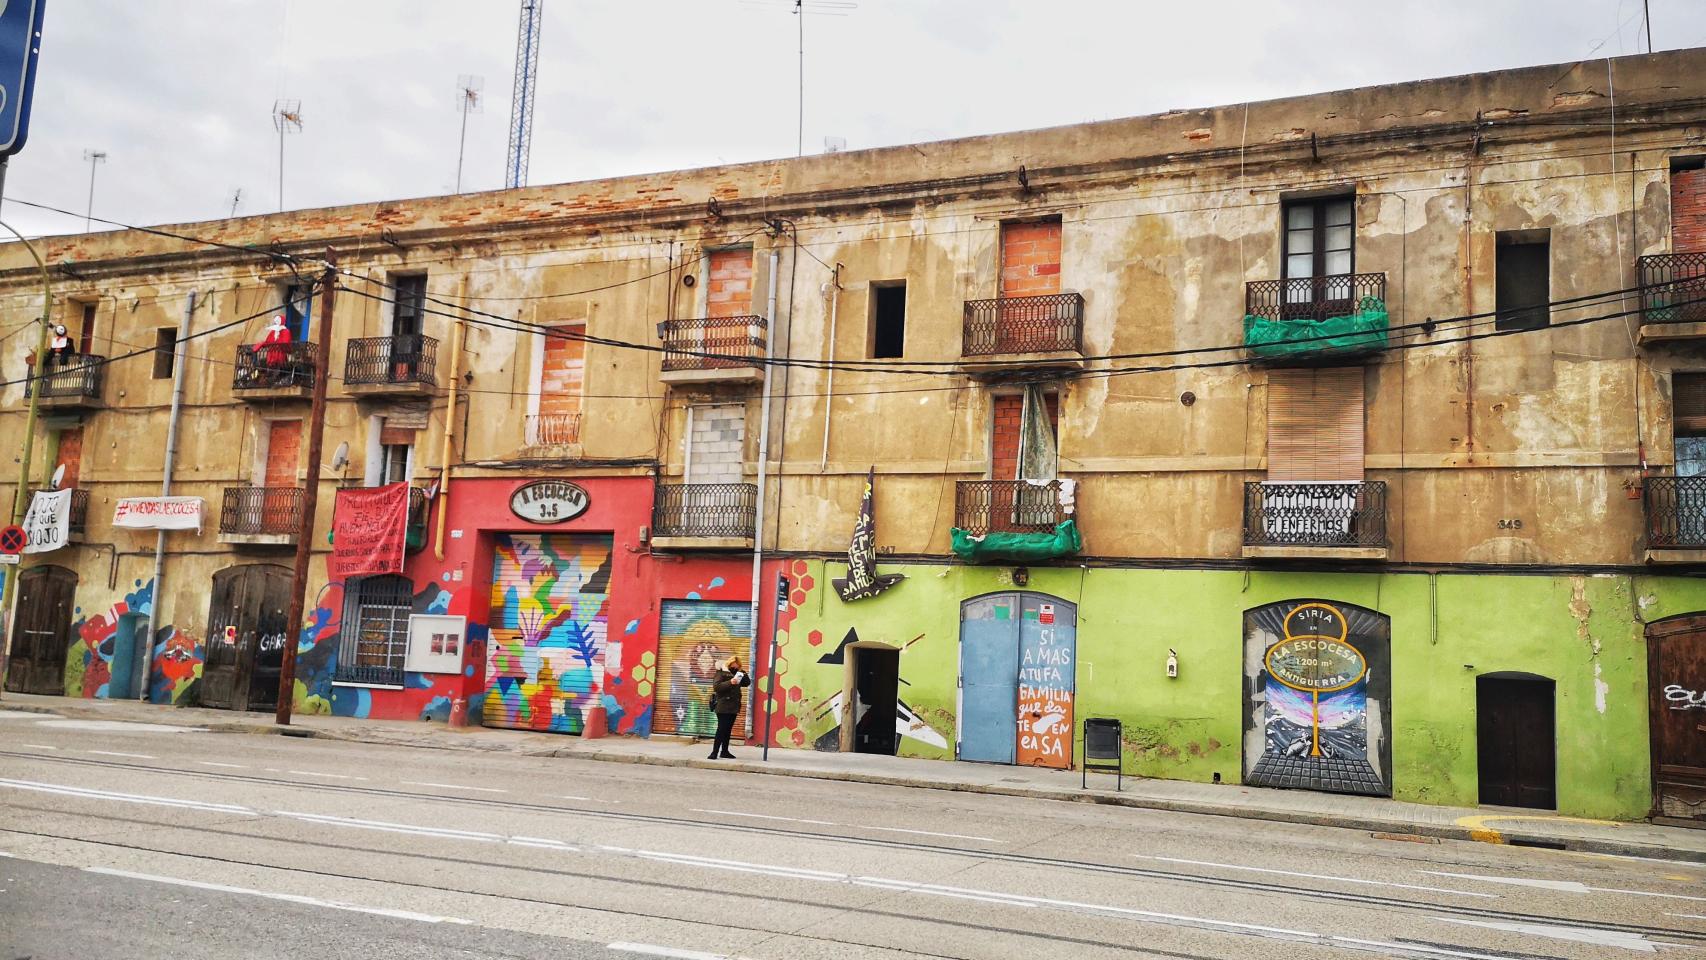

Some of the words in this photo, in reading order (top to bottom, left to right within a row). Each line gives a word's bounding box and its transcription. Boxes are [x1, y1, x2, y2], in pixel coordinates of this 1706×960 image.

[1282, 519, 1344, 532] ENFERMOS
[1298, 609, 1333, 623] SIRIA
[1273, 646, 1291, 660] LA
[1293, 640, 1358, 665] ESCOCESA
[1296, 658, 1318, 667] 1200
[1280, 668, 1347, 687] ANTIGUERRA
[1016, 719, 1030, 732] TE
[1051, 723, 1070, 735] EN
